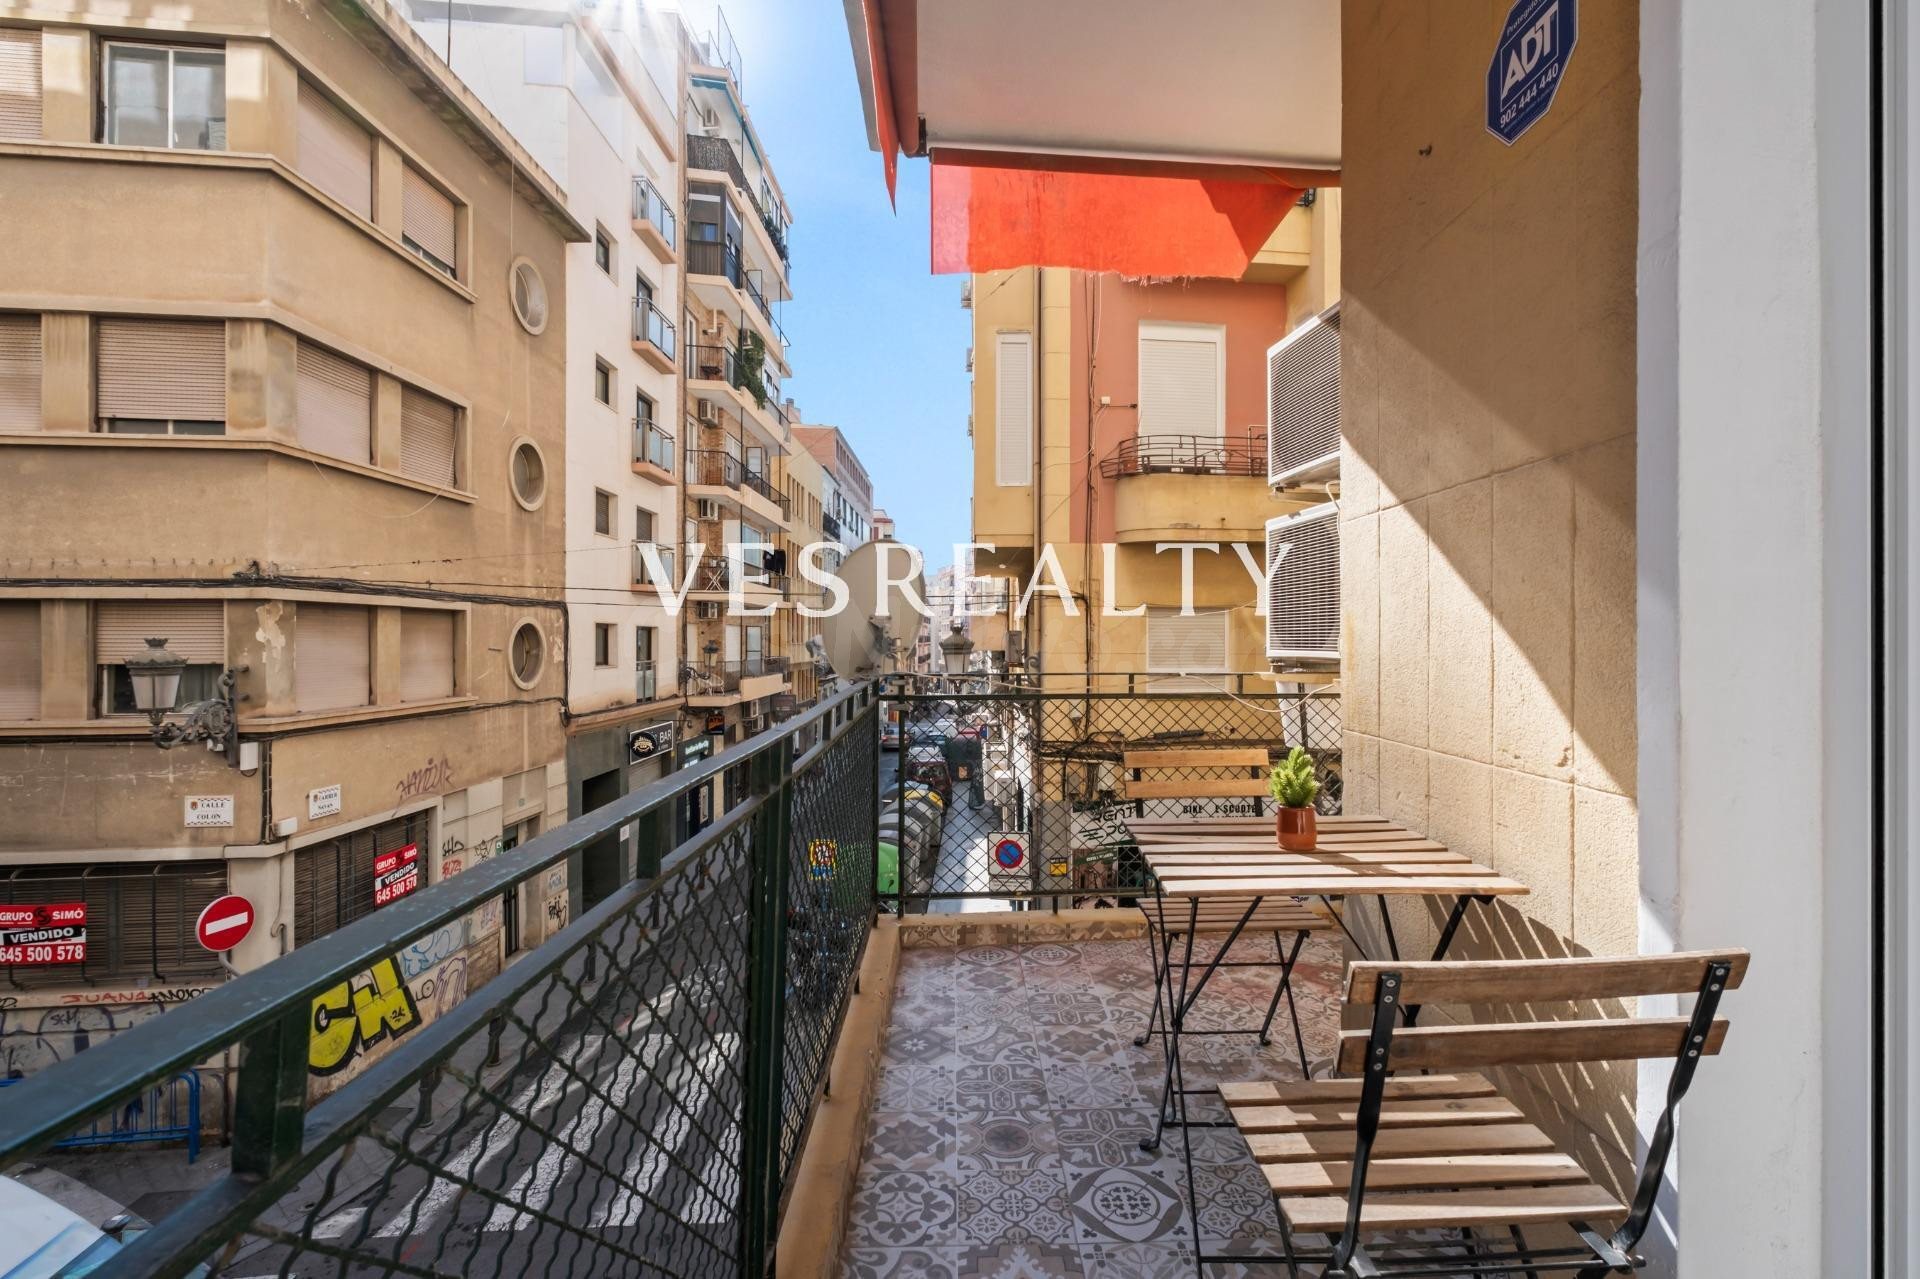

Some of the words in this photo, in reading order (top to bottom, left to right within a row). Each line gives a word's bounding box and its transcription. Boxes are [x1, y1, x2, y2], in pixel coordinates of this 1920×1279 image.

[1502, 2, 1558, 99] ADT
[1501, 104, 1517, 128] 902
[1519, 84, 1537, 108] 444
[1539, 63, 1559, 88] 440
[659, 729, 672, 743] BAR
[376, 857, 396, 870] GRUPO
[385, 862, 415, 884] VENDIDO
[376, 888, 390, 904] 645
[393, 881, 405, 897] 500
[0, 912, 33, 921] GRUPO
[52, 908, 84, 920] SIMÓ
[10, 928, 74, 943] VENDIDO
[0, 947, 22, 962] 645
[27, 946, 52, 962] 500
[57, 945, 83, 960] 578
